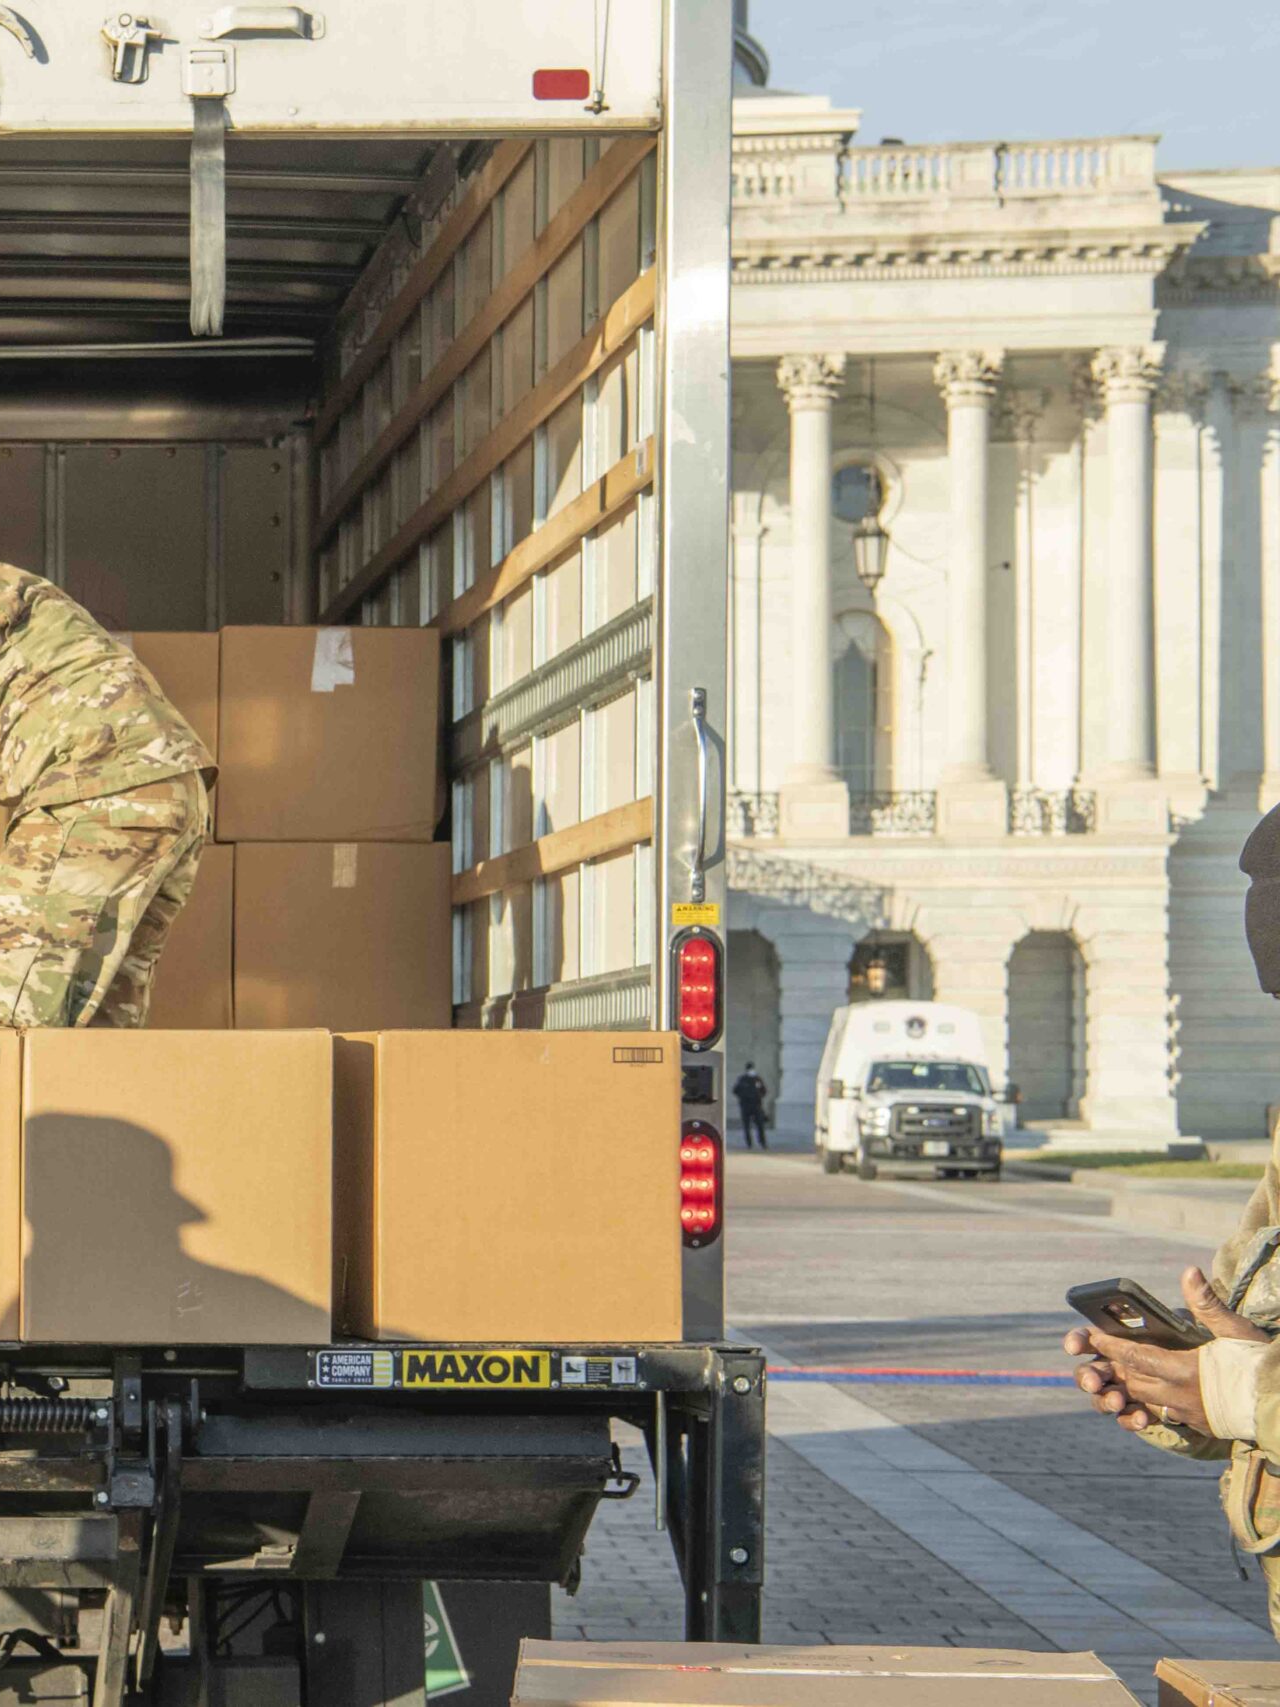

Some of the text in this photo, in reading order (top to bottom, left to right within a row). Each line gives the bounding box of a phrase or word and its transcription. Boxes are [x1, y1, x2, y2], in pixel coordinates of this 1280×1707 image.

[331, 1354, 371, 1365] AMERICAN
[331, 1366, 371, 1376] COMPANY
[405, 1354, 541, 1383] MAXON
